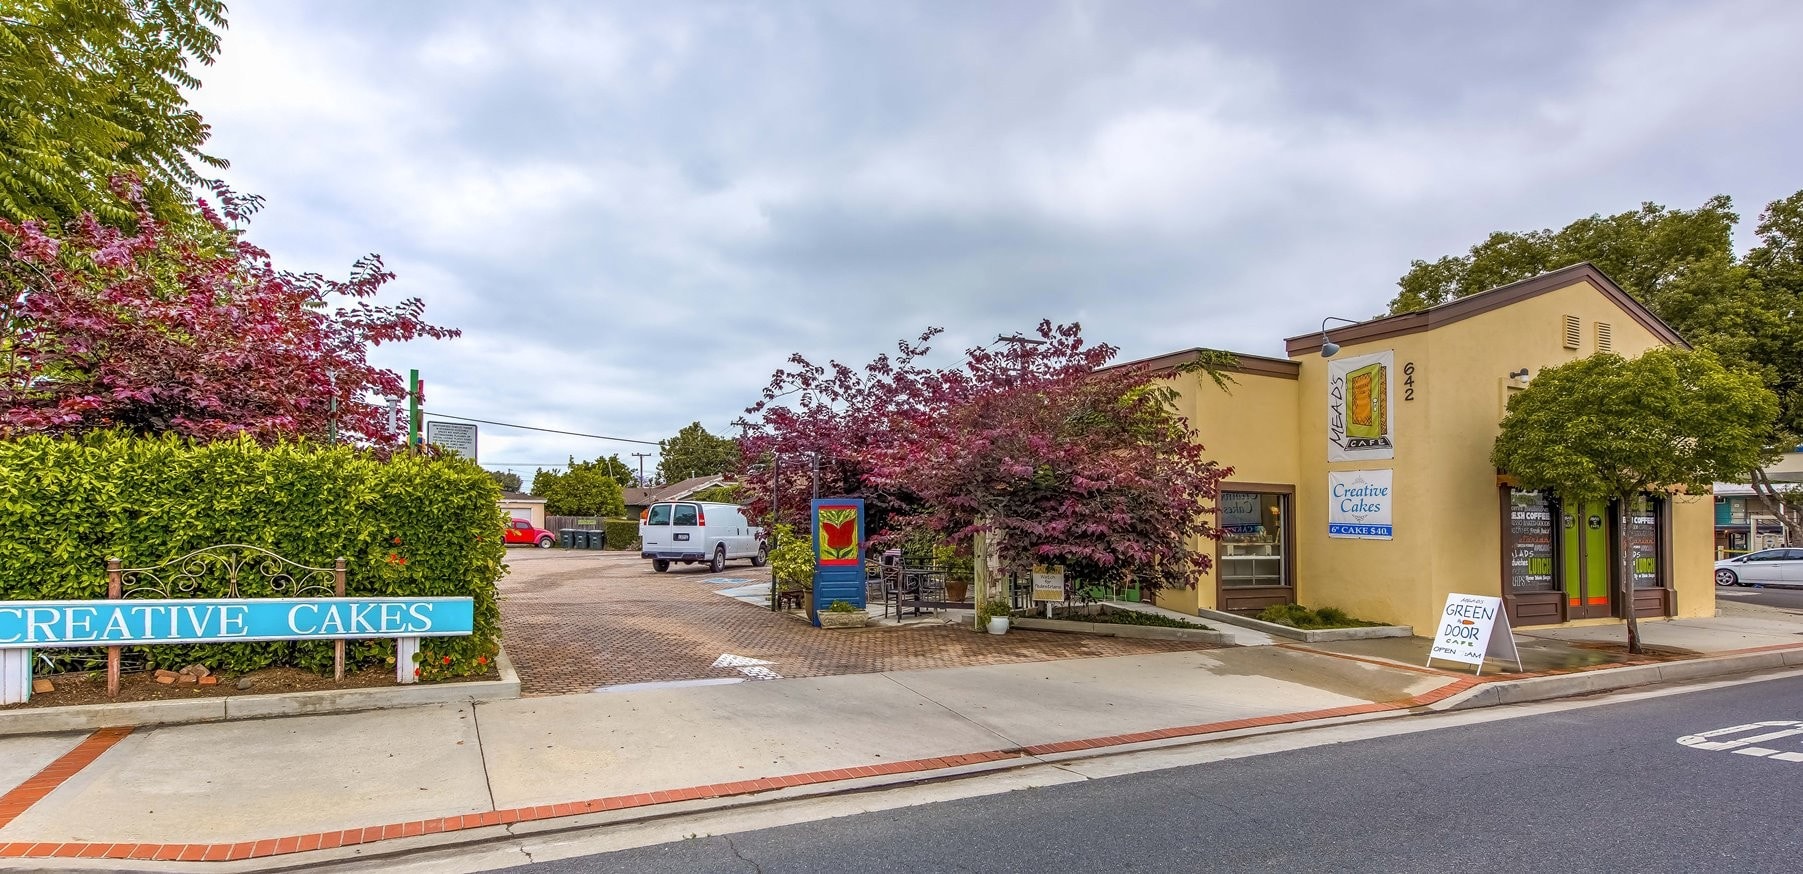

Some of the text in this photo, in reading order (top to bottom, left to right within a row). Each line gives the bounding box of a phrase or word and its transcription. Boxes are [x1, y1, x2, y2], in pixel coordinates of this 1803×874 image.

[1403, 362, 1415, 401] 642
[1329, 374, 1344, 449] MEAD'S
[1333, 483, 1388, 498] Creative
[1340, 498, 1381, 513] Cakes
[1525, 512, 1551, 520] COFFEE
[1633, 516, 1655, 525] COFFEE
[1341, 526, 1369, 534] CAKE
[1446, 603, 1494, 620] GREEN
[0, 602, 434, 643] CREATIVE CAKES
[1444, 624, 1479, 640] DOOR
[1433, 646, 1456, 654] OPEN
[1446, 638, 1474, 647] CAFE
